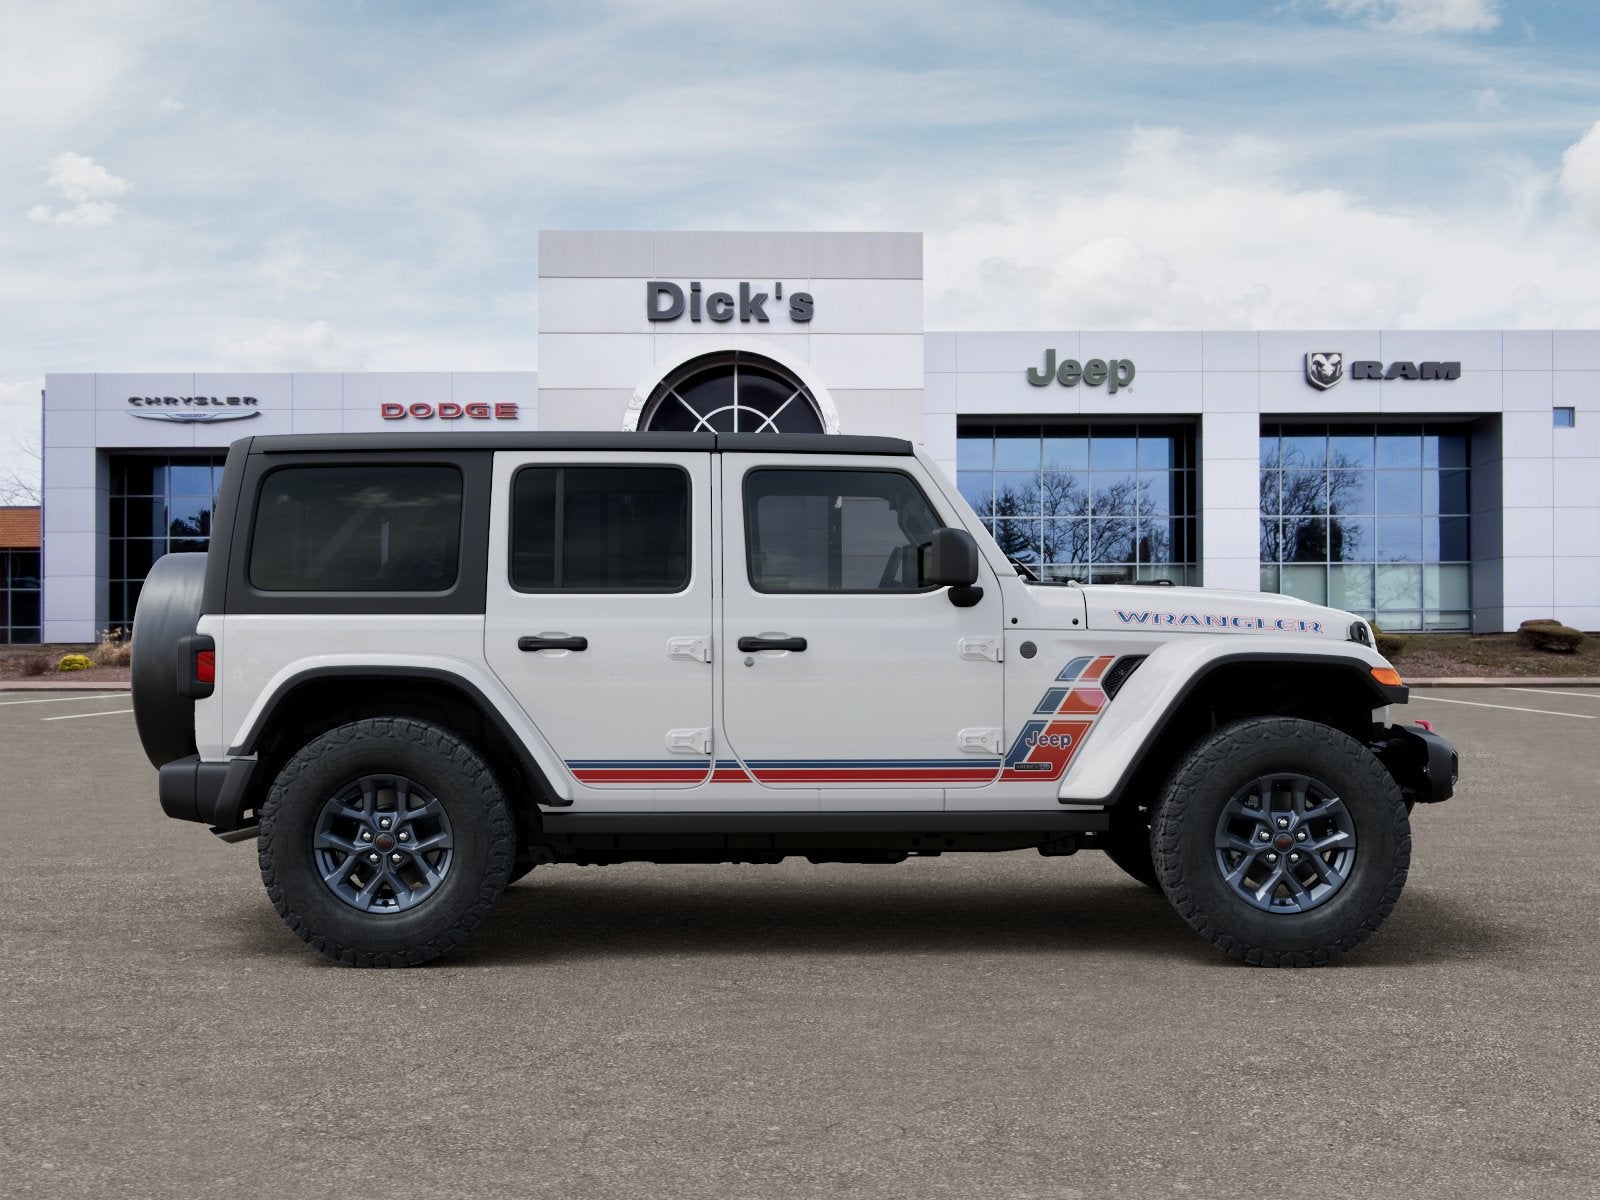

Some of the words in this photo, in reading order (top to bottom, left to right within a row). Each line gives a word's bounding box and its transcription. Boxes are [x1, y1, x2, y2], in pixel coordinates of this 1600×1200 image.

[647, 281, 814, 323] Dick's
[1026, 348, 1136, 394] Jeep
[1352, 360, 1461, 380] RAM
[127, 396, 258, 407] CHRYSLER
[381, 402, 518, 420] DODGE
[1114, 609, 1323, 634] WRANGLER
[1025, 730, 1072, 750] Jeep
